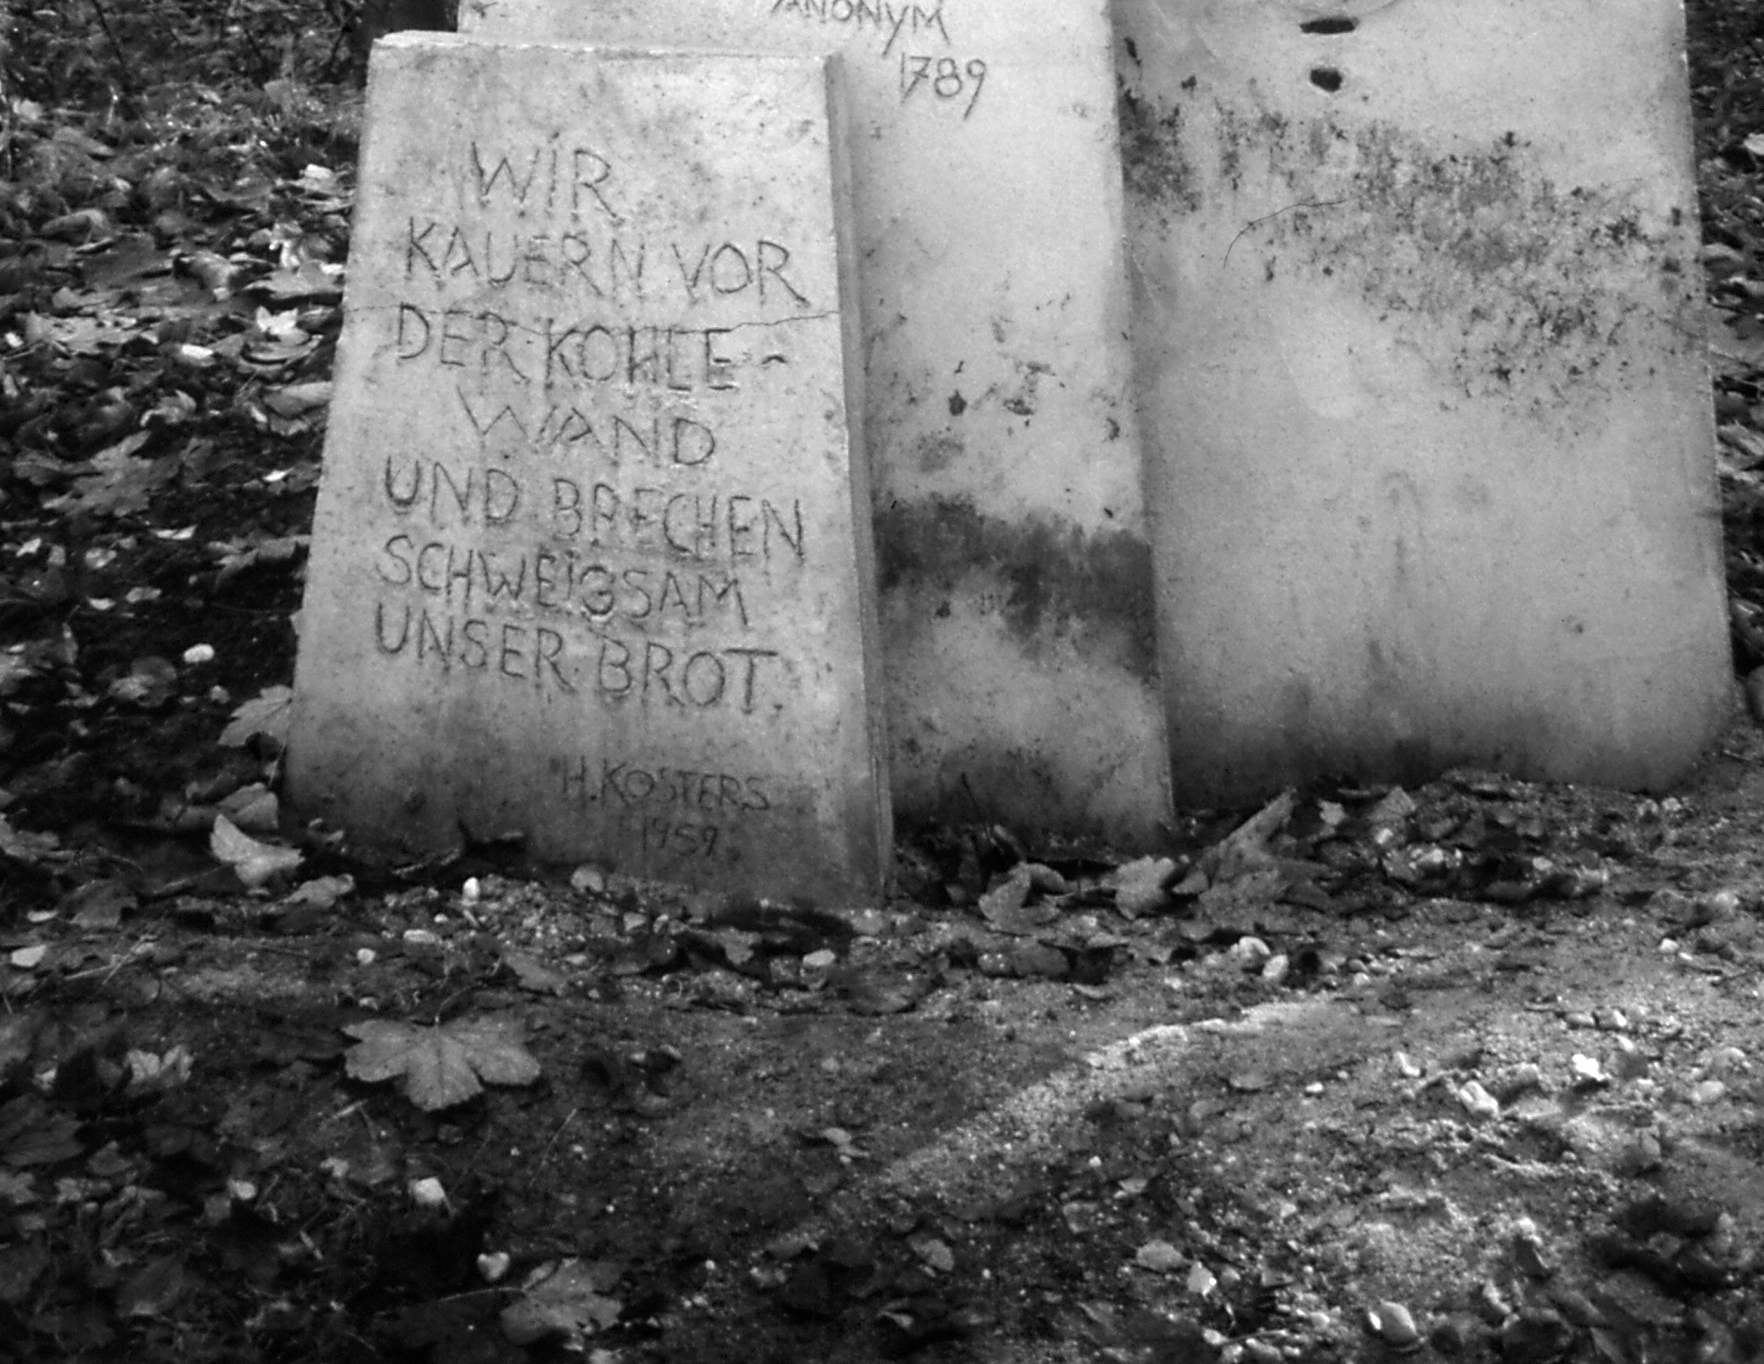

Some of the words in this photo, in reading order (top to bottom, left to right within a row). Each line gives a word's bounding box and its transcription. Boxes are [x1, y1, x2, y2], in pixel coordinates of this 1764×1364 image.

[900, 51, 987, 120] 1789
[471, 133, 624, 226] WIR
[406, 216, 646, 300] KAUERN
[670, 239, 810, 307] VOR
[398, 302, 531, 383] DER
[456, 384, 716, 468] WAND
[385, 455, 519, 527] UND
[553, 477, 806, 562] BRECHEN
[376, 533, 749, 626] SCHWEIGSAM
[375, 601, 576, 695] UNSER
